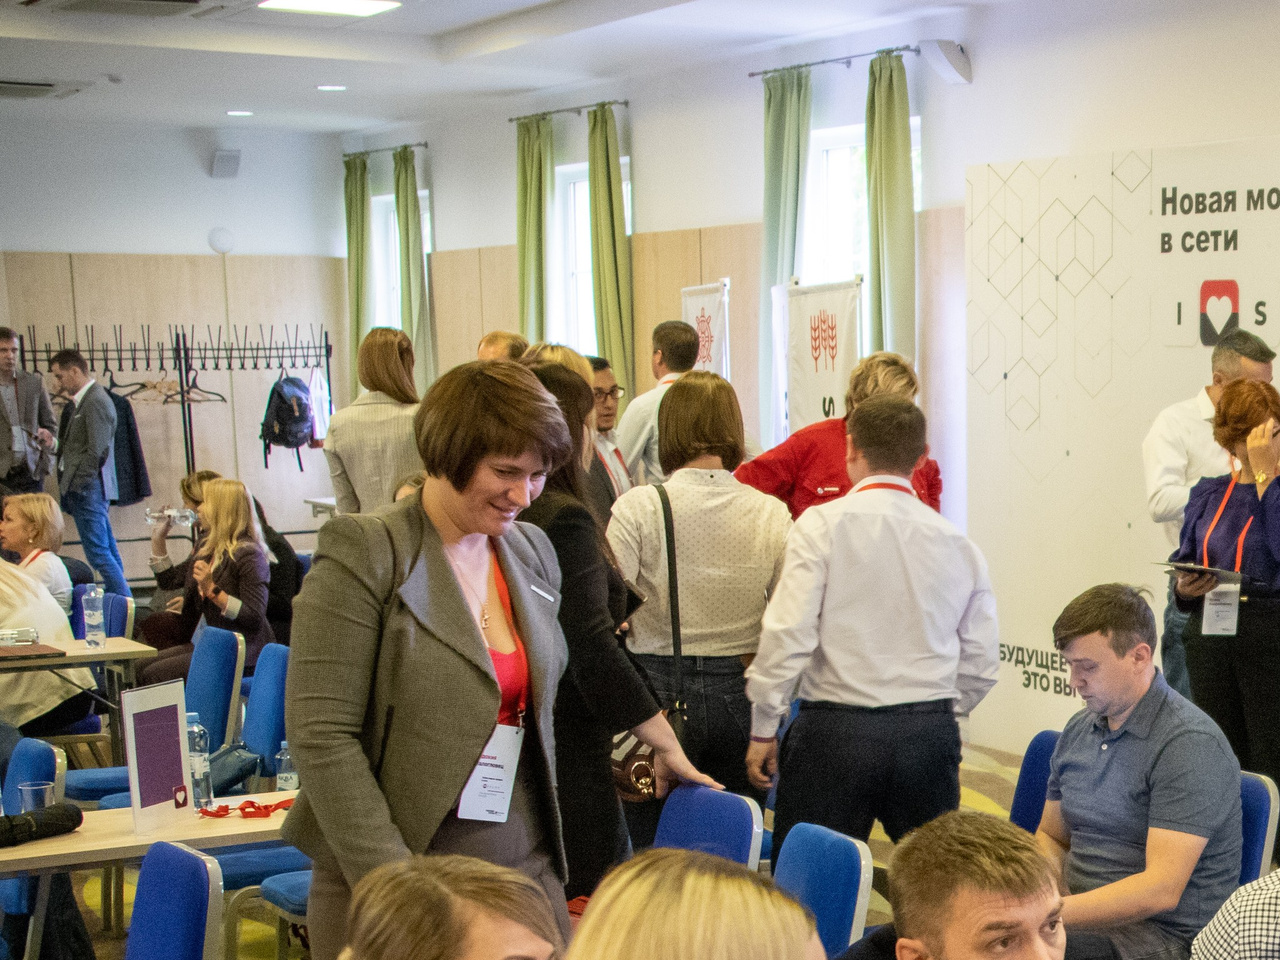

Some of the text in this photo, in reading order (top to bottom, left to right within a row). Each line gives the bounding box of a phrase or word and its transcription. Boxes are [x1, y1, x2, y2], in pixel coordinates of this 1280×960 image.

[1161, 186, 1237, 216] Новая
[1160, 229, 1239, 253] в сети
[999, 642, 1068, 673] БУДУЩЕЕ
[1022, 669, 1051, 692] ЭТО
